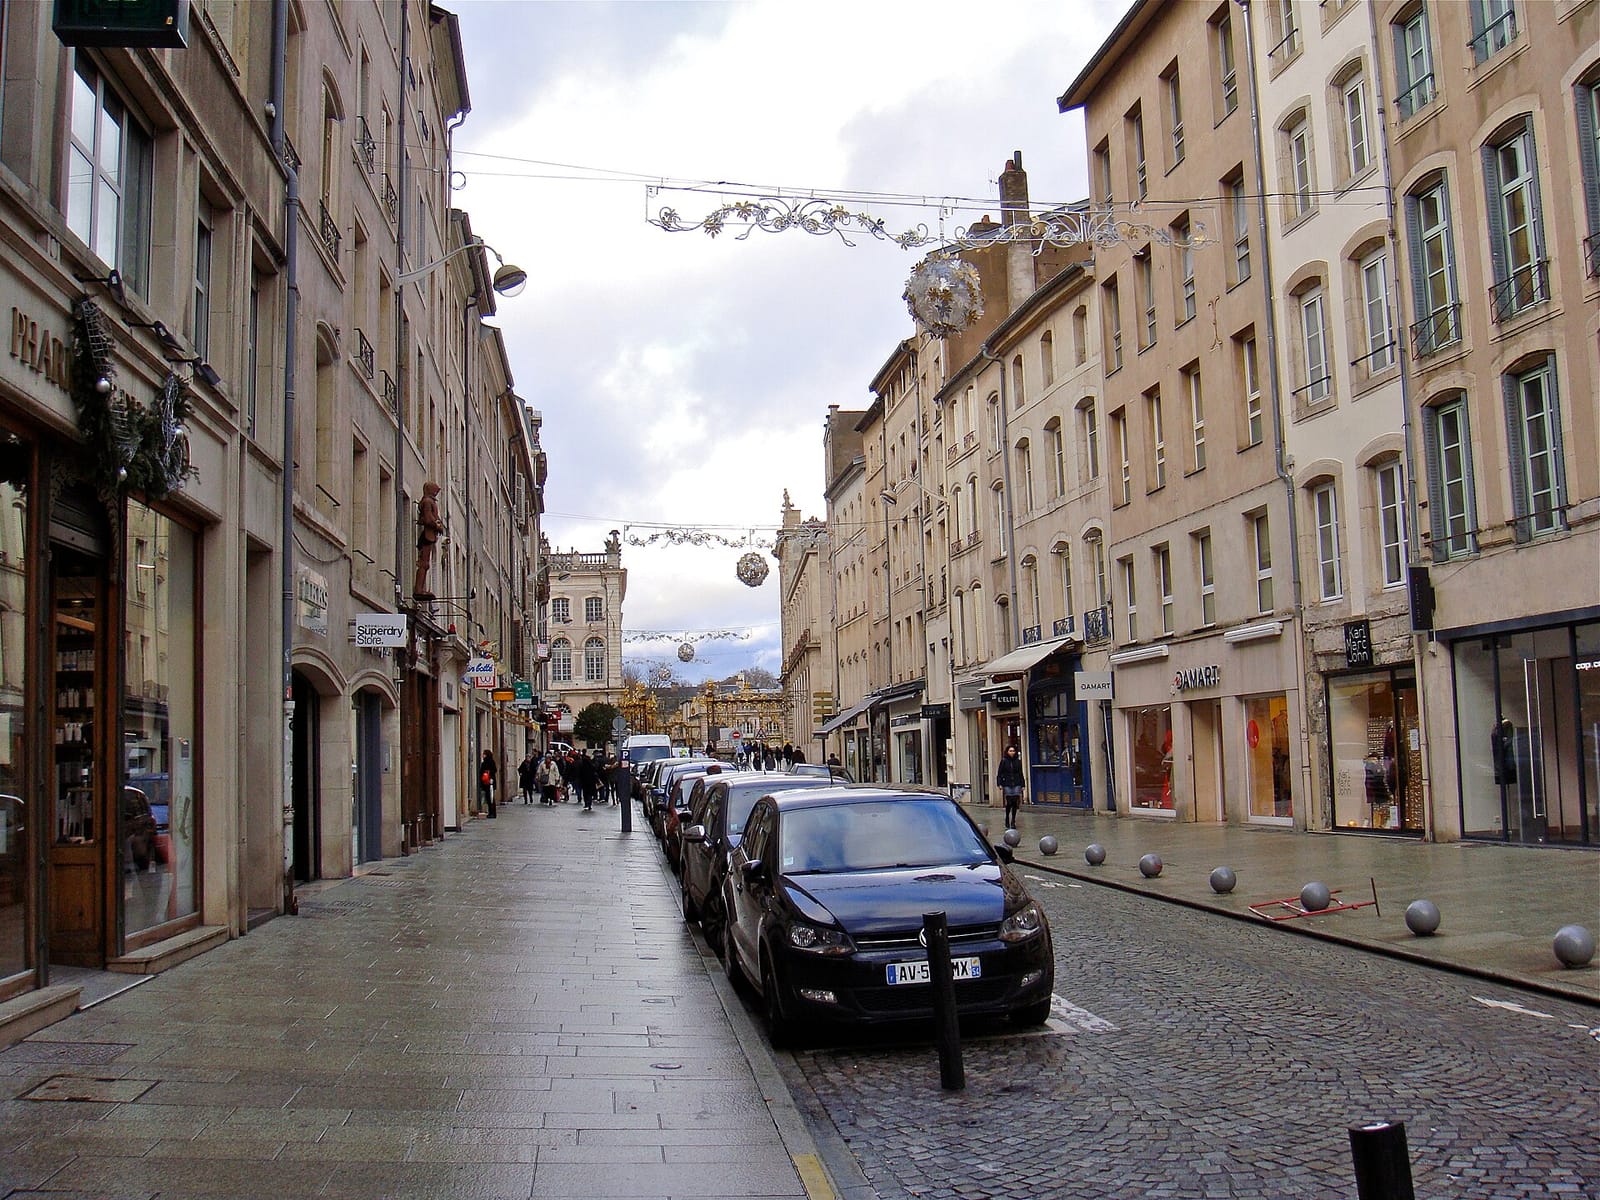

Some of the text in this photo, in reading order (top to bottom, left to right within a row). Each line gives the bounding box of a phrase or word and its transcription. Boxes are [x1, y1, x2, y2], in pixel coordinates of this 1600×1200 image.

[357, 625, 404, 638] Superdry
[1348, 624, 1367, 639] Karl
[1346, 638, 1367, 651] Marc
[1348, 650, 1369, 663] John
[1175, 665, 1219, 690] DAMART
[1080, 682, 1111, 691] DAMART
